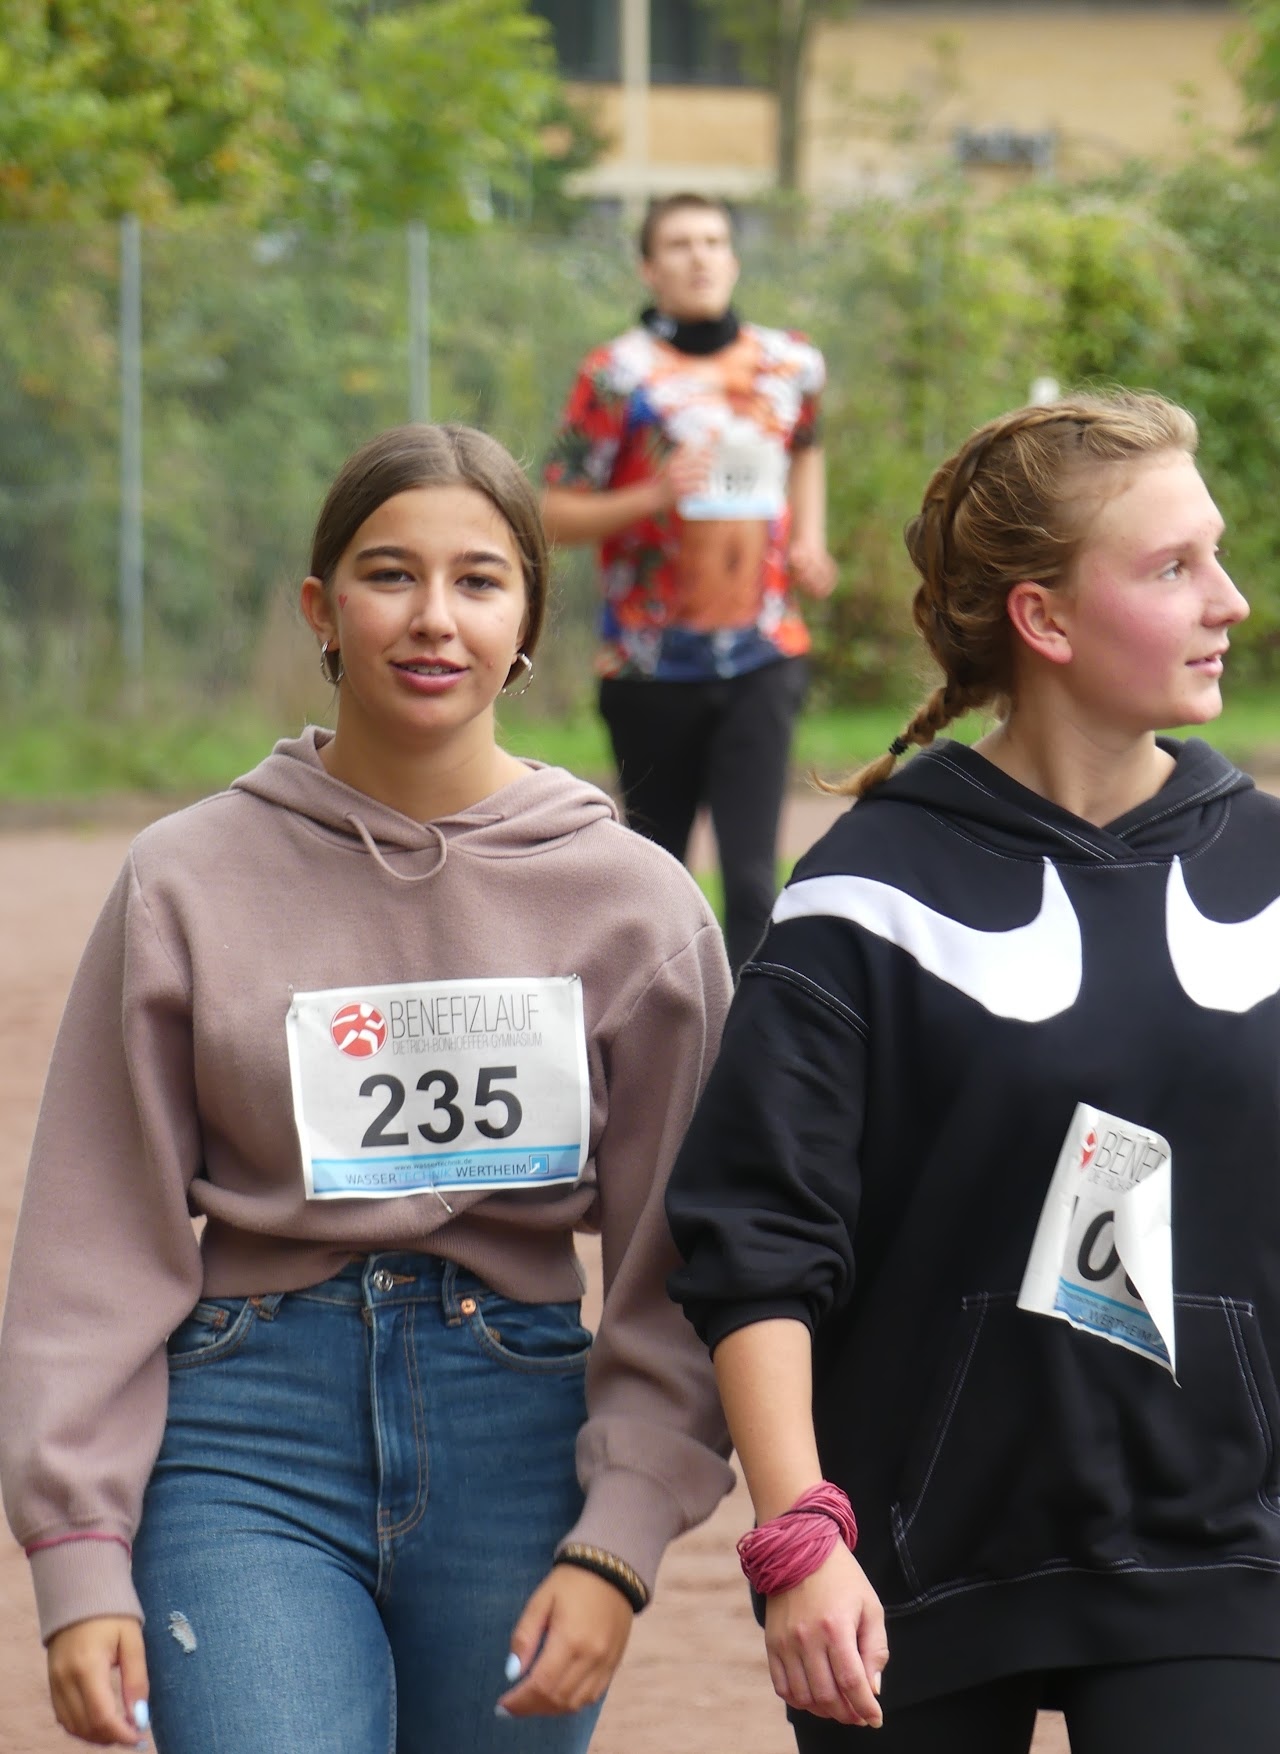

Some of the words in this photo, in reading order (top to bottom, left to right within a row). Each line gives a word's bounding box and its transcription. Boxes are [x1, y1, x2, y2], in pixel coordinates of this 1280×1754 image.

[390, 994, 539, 1039] BENEFIZLAUF
[358, 1065, 523, 1148] 235
[455, 1163, 528, 1178] WERTHEIM
